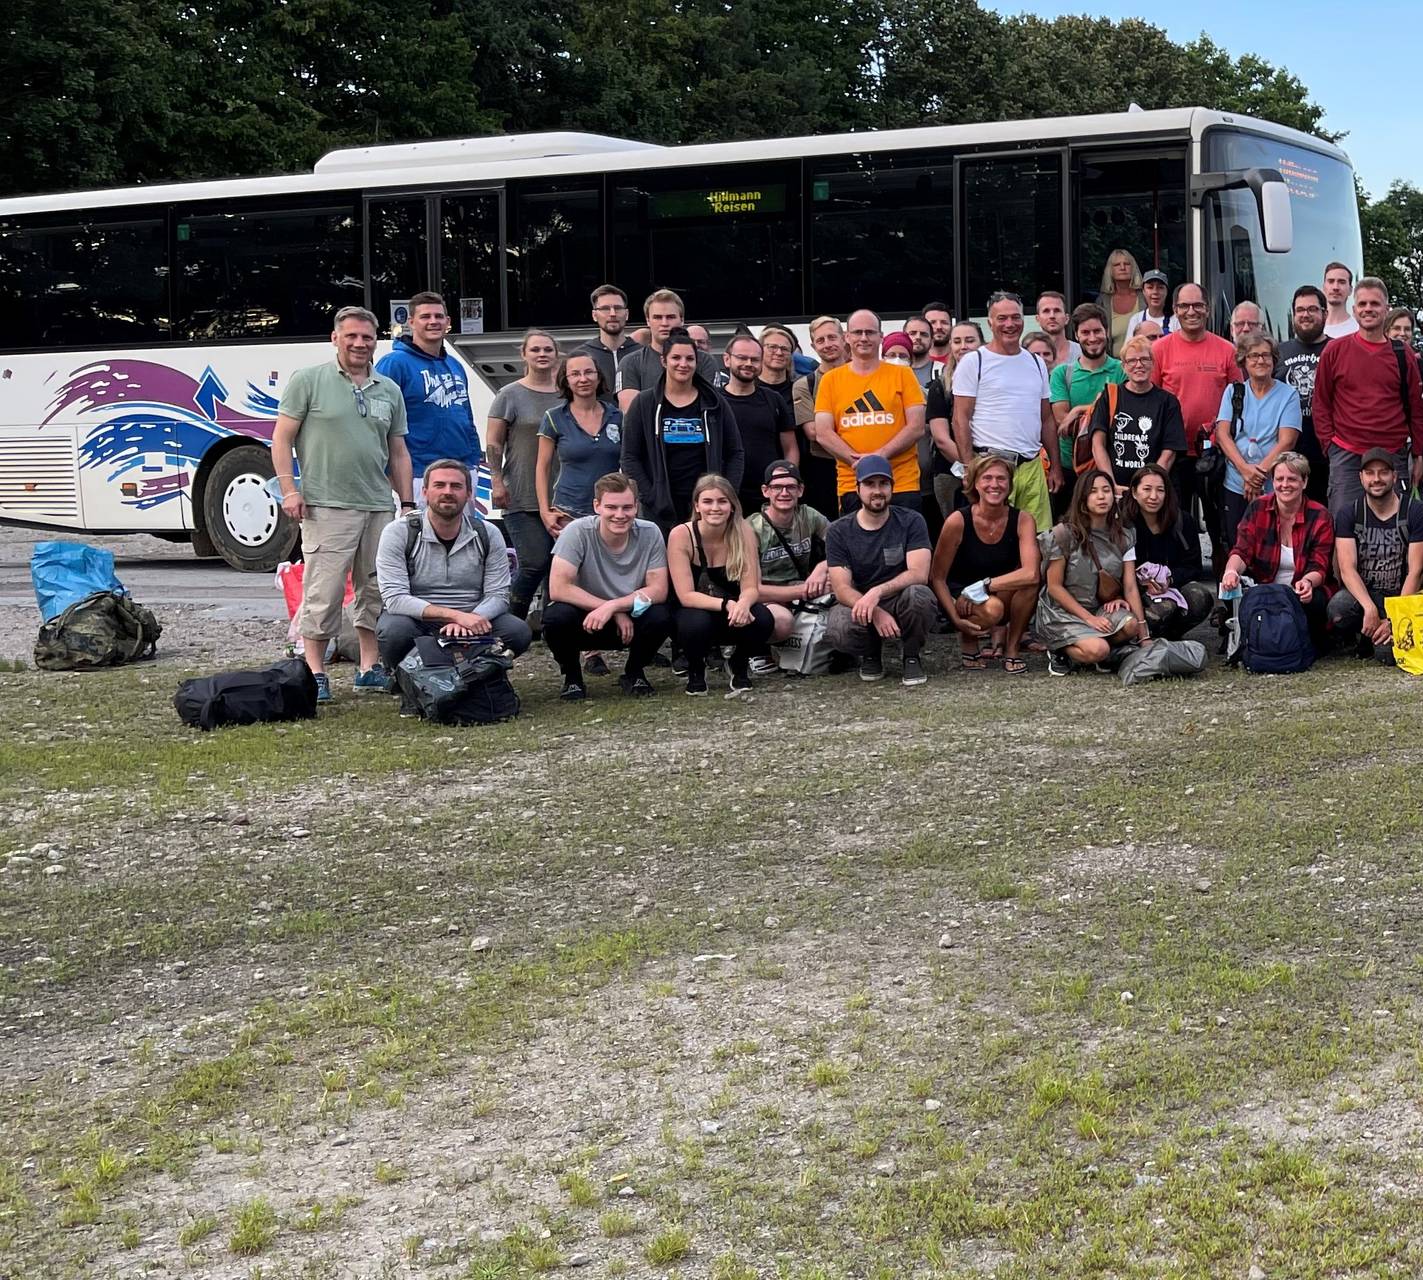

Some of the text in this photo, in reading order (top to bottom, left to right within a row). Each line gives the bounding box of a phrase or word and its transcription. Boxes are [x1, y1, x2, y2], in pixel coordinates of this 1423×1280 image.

[714, 202, 756, 213] Reisen
[1284, 353, 1320, 366] motörhe
[841, 412, 894, 428] adidas
[1124, 460, 1146, 469] WORLD
